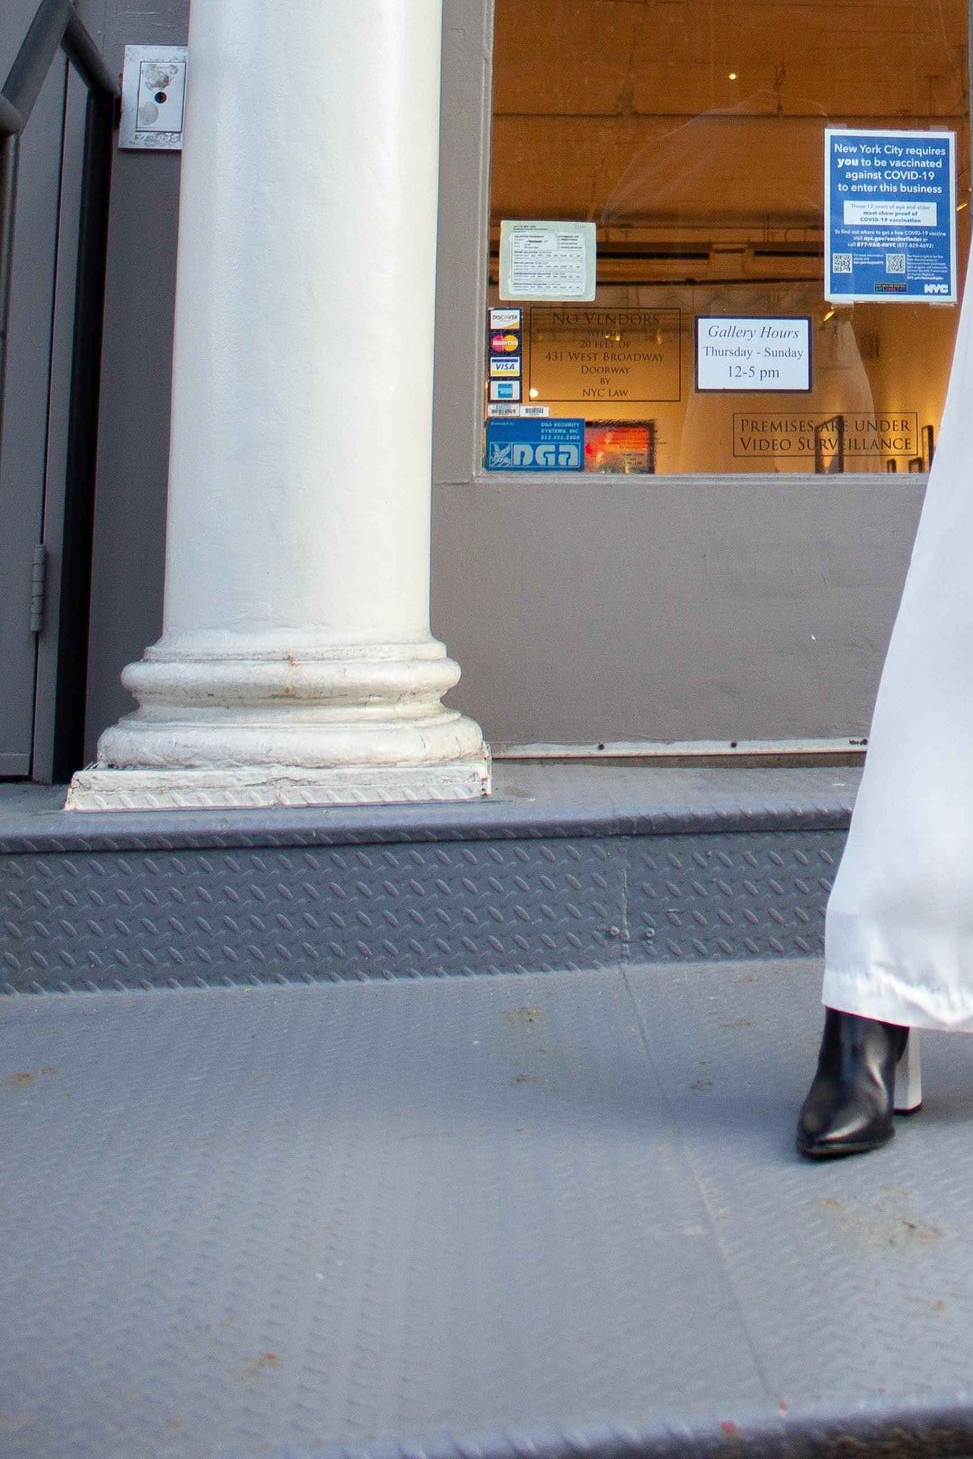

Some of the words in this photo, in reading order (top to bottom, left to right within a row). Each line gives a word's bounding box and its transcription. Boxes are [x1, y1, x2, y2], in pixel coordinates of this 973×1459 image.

[834, 143, 857, 153] New
[859, 144, 881, 154] York
[884, 145, 903, 156] City
[906, 146, 946, 157] requires
[837, 158, 859, 168] you
[861, 158, 871, 166] to
[874, 157, 887, 167] be
[889, 158, 942, 168] vaccinated
[845, 170, 881, 181] against
[884, 170, 935, 180] COVID-19
[838, 183, 848, 192] to
[851, 184, 878, 192] enter
[880, 183, 897, 192] this
[900, 183, 942, 193] business
[924, 283, 949, 293] NYC
[552, 312, 578, 325] NO
[584, 312, 660, 325] VENDORS
[708, 325, 756, 341] Gallery
[760, 326, 799, 339] Hours
[580, 340, 591, 348] 20
[545, 352, 564, 362] 431
[568, 351, 599, 362] WEST
[603, 352, 664, 363] BROADWAY
[703, 346, 753, 360] Thursday
[764, 347, 804, 361] Sunday
[581, 365, 630, 375] DOORWAY
[728, 365, 755, 378] 12-5
[760, 368, 780, 381] pm
[600, 377, 610, 386] BY
[582, 388, 603, 397] NYC
[608, 388, 628, 397] LAW
[741, 419, 814, 432] PREMISES
[819, 419, 849, 432] ARE
[855, 419, 910, 432] UNDER
[740, 437, 792, 451] VIDEO
[798, 437, 912, 451] SURVEILLANCE
